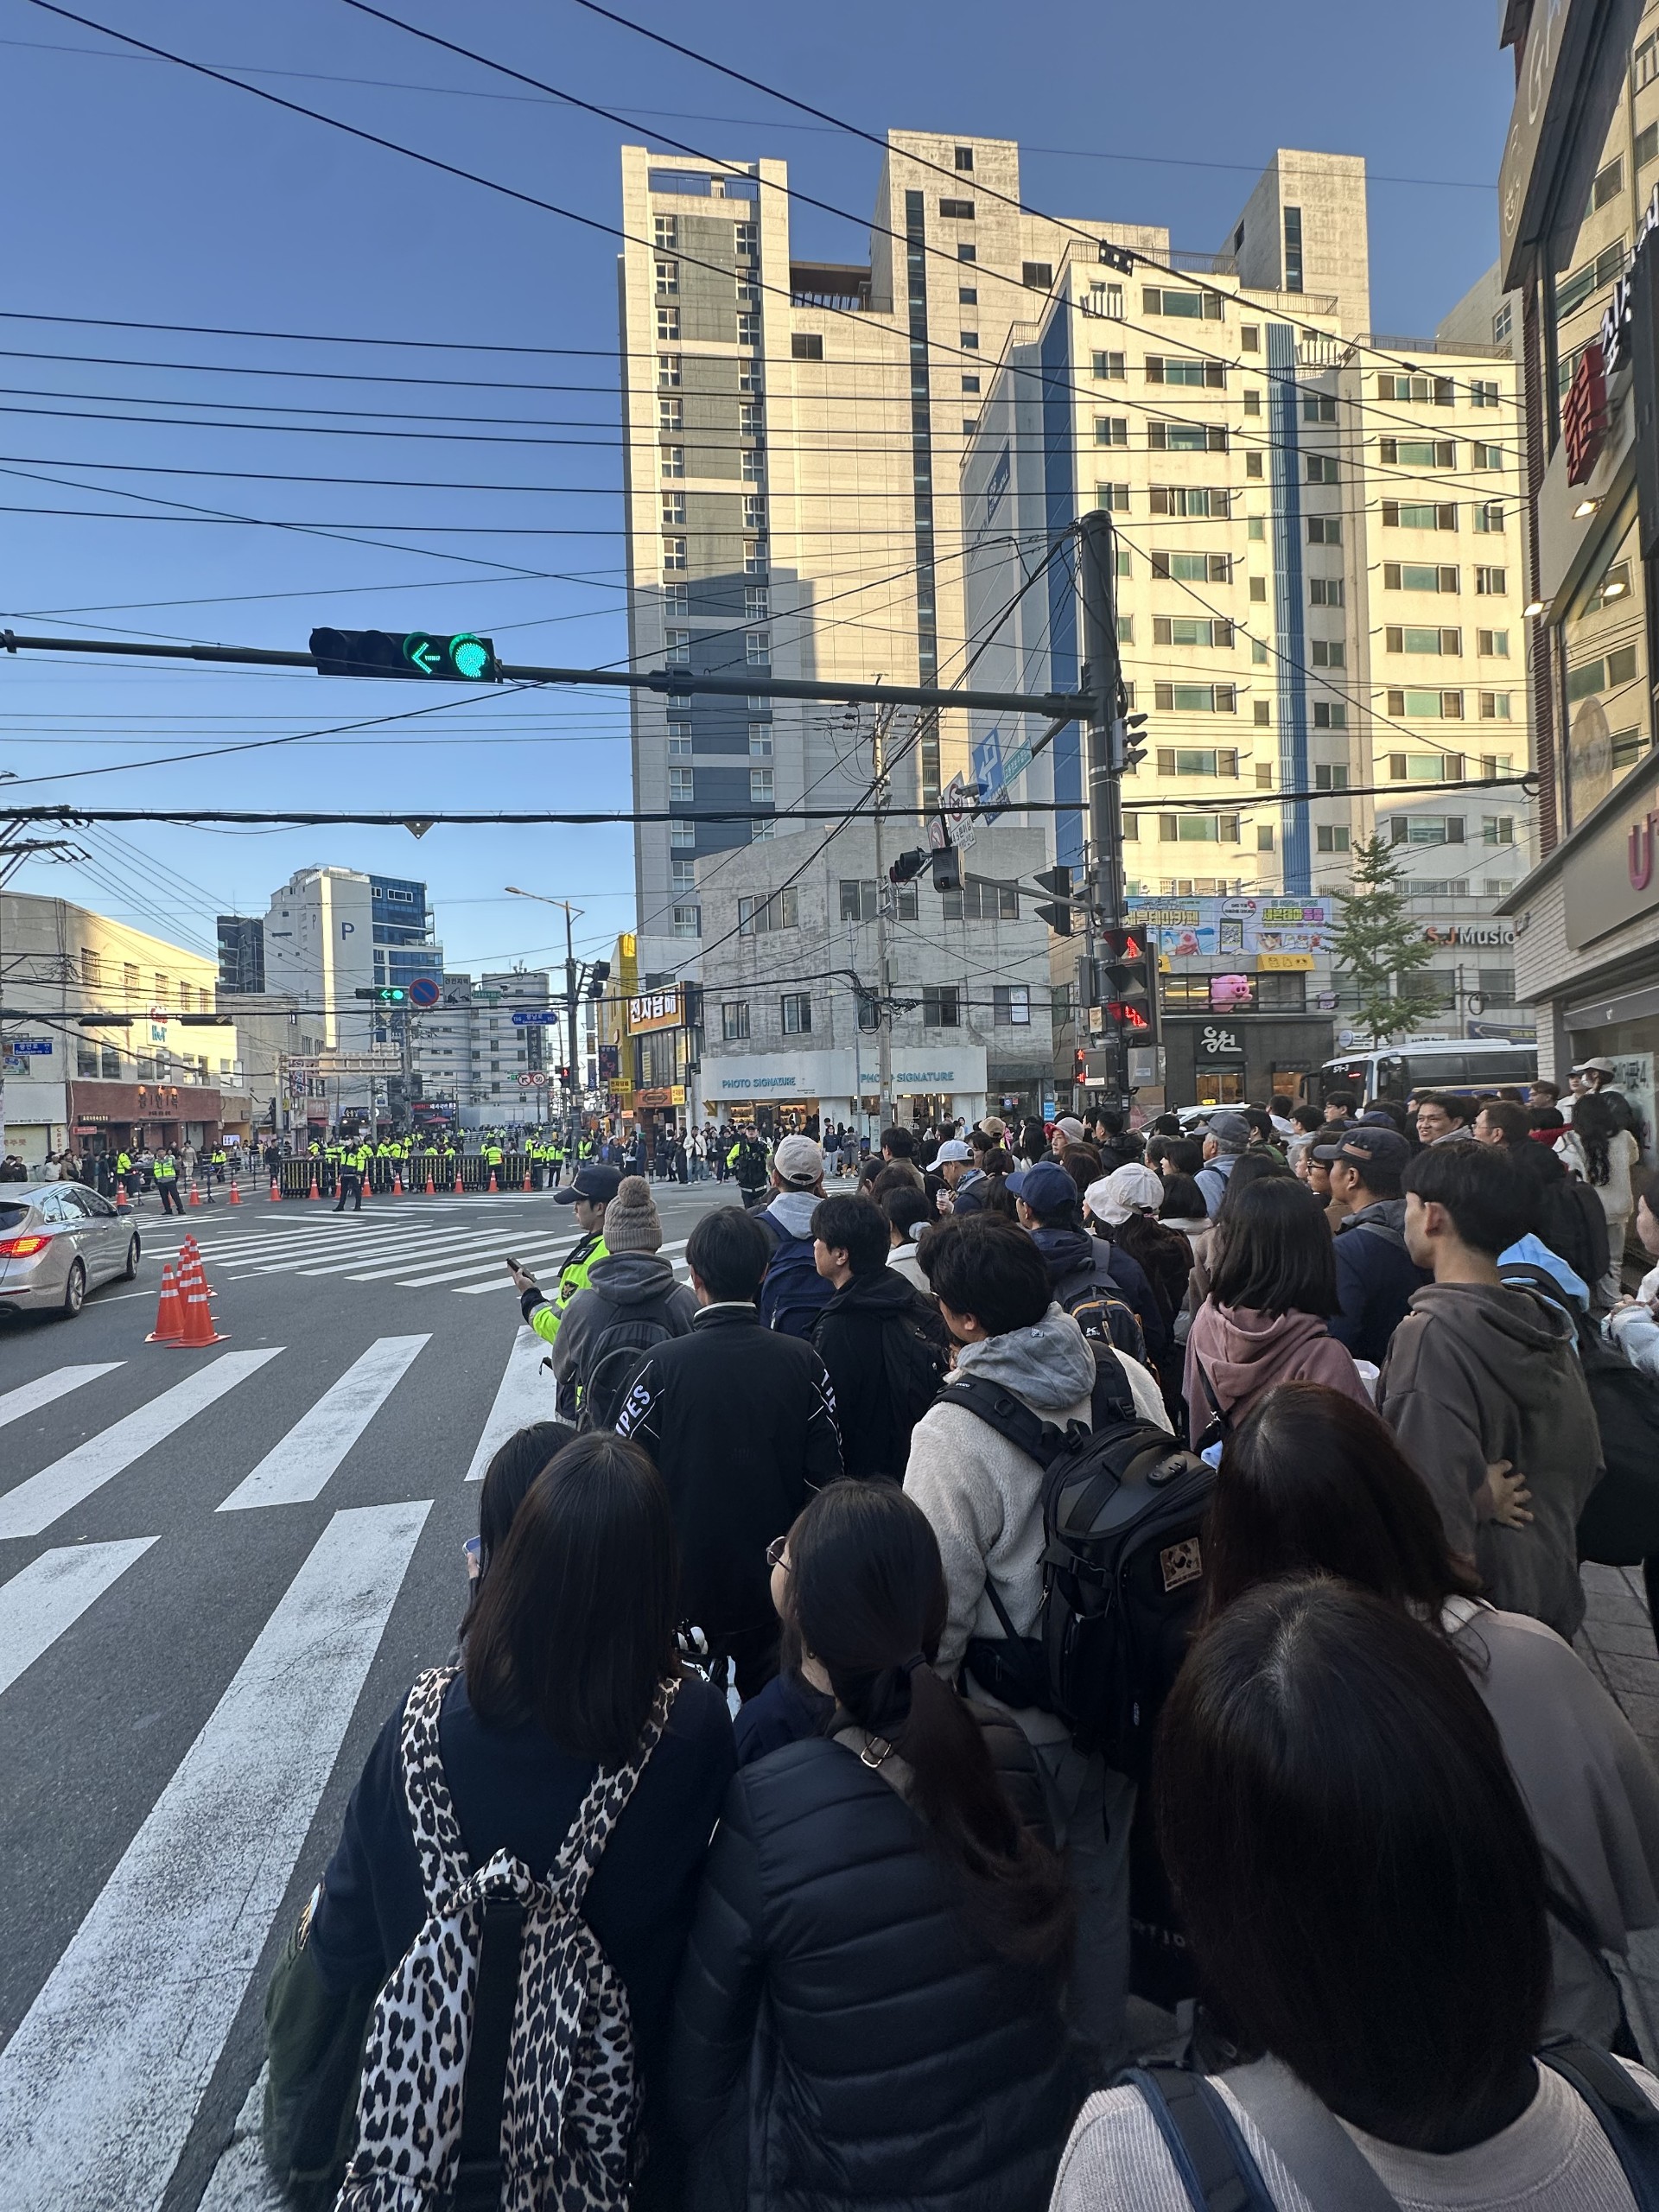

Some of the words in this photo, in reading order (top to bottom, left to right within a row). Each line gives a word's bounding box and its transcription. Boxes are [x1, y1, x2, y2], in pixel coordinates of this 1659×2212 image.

[341, 921, 355, 941] P
[897, 1071, 954, 1082] SIGNATURE
[722, 1079, 751, 1089] PHOTO
[753, 1077, 796, 1088] SIGNATURE
